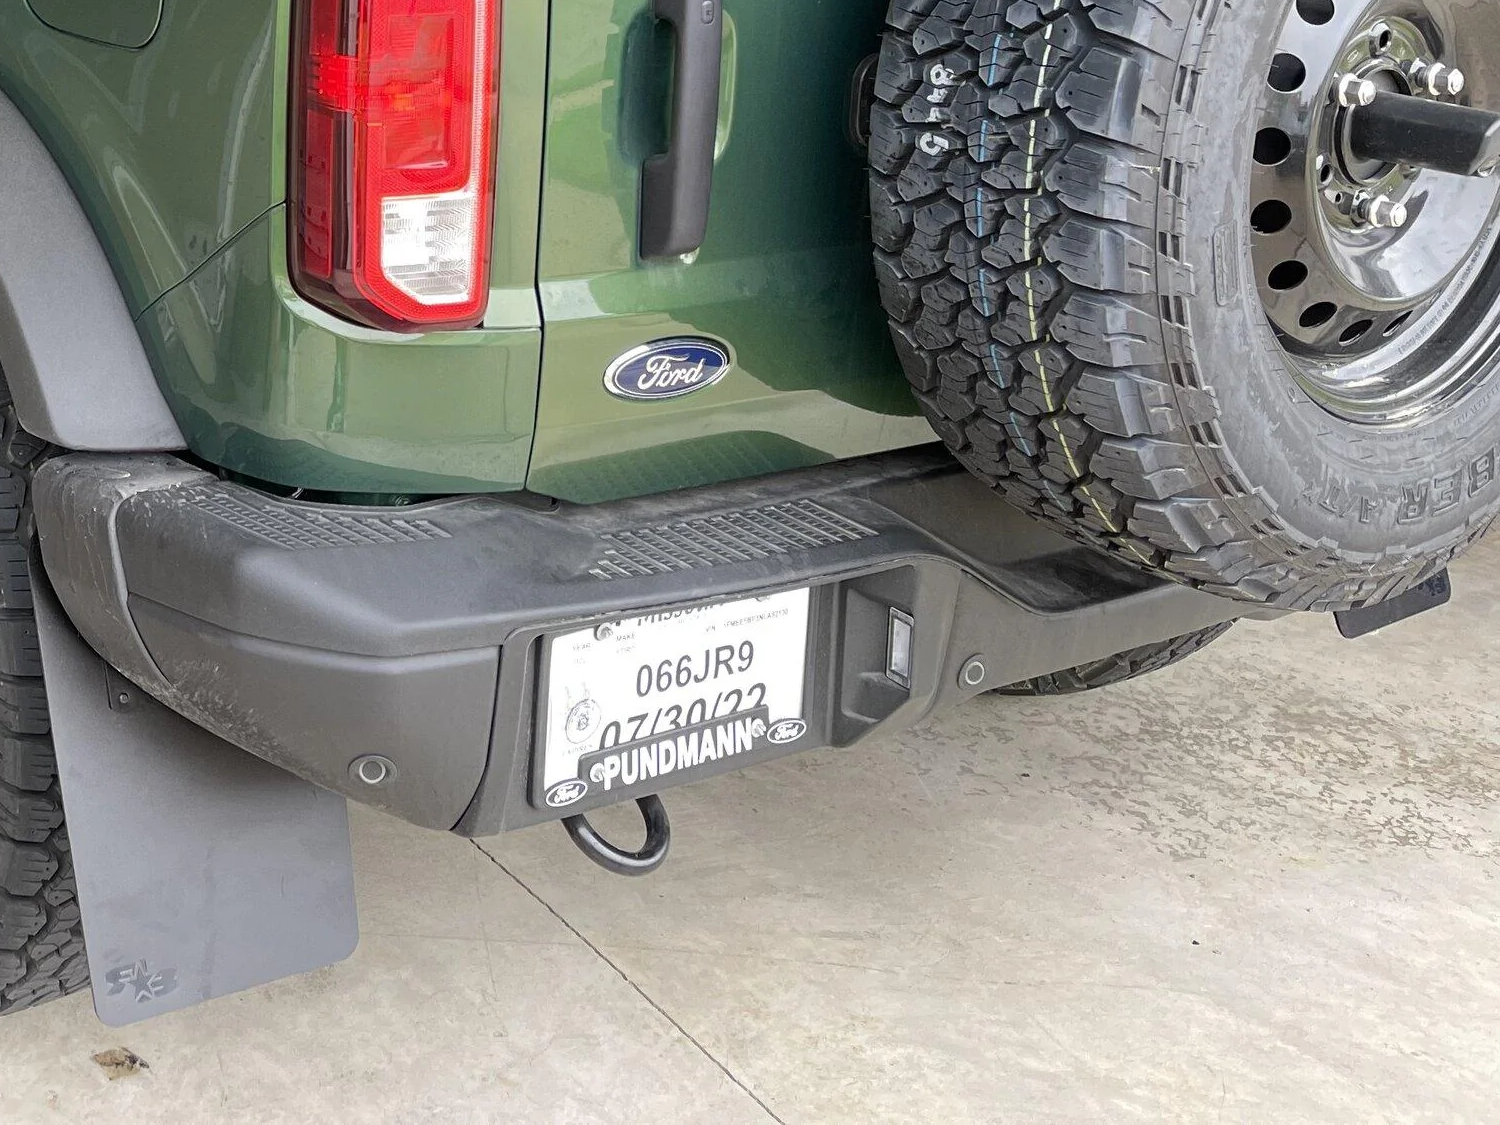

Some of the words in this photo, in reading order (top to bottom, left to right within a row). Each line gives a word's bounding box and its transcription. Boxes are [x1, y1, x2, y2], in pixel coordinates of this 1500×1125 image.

[637, 354, 706, 390] Ford
[636, 640, 754, 697] 066JR9
[599, 682, 768, 751] 07/30/22
[603, 717, 753, 791] PUNDMANN
